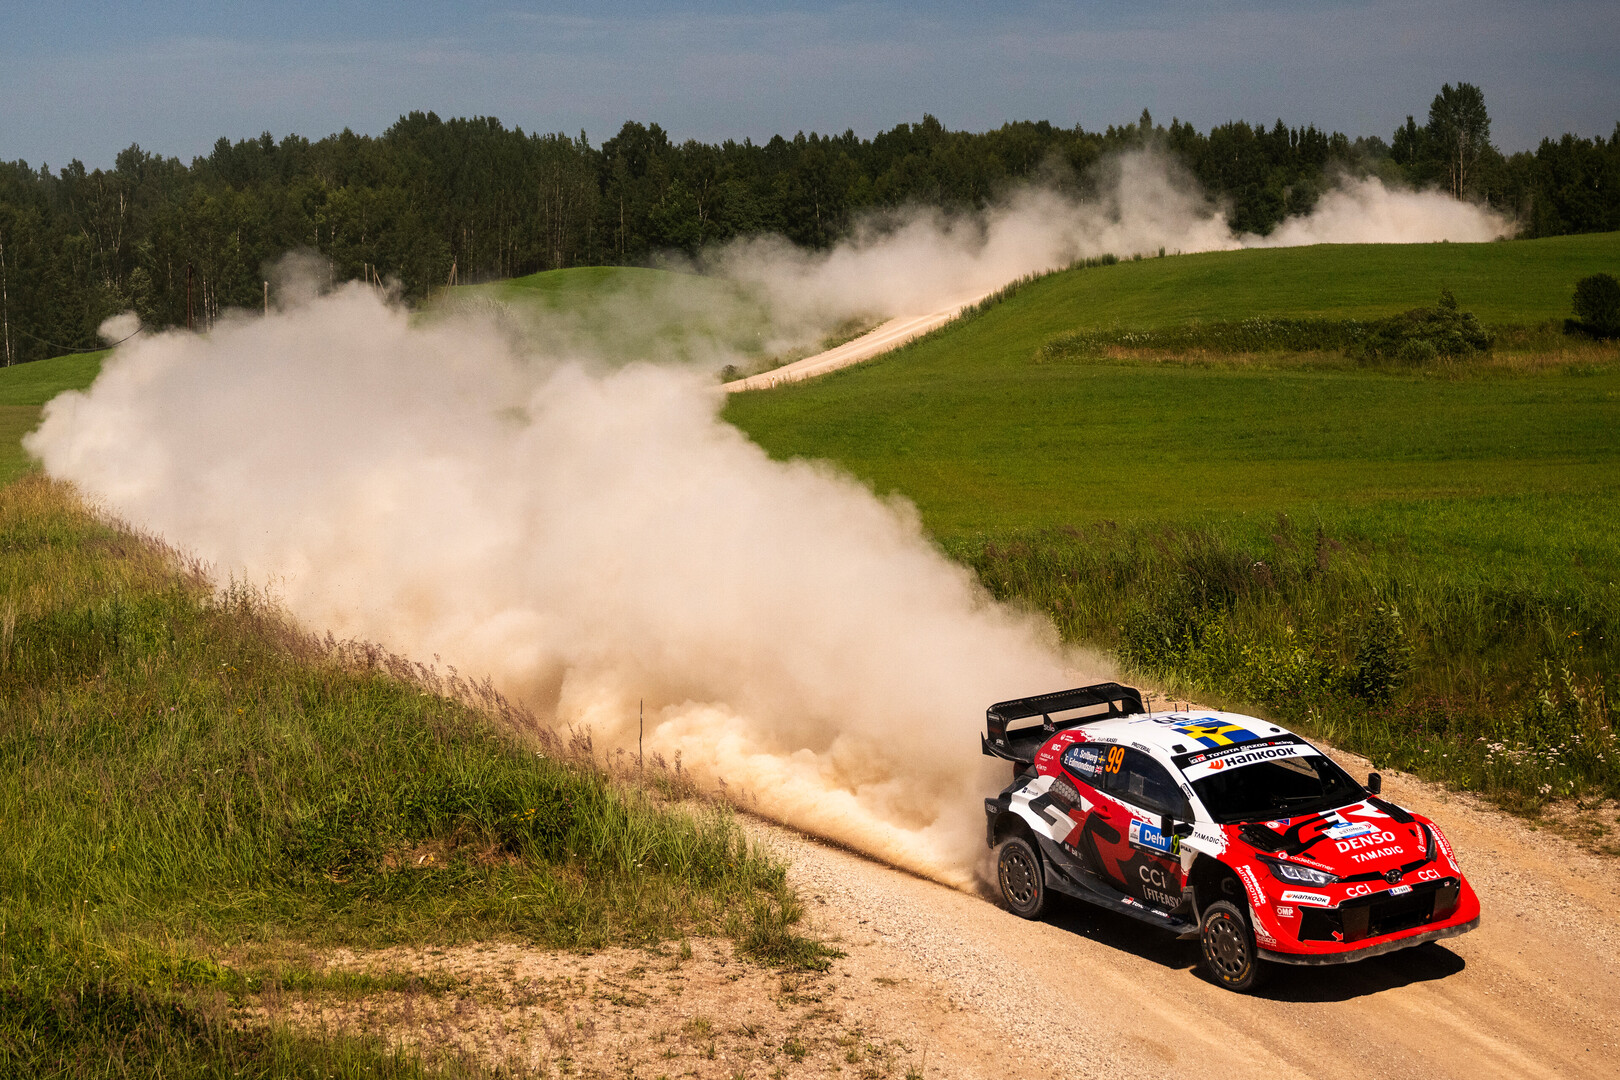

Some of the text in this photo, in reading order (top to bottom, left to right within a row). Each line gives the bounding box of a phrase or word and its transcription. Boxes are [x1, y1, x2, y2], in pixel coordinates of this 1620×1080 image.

[1073, 748, 1098, 765] O. Solberg
[1105, 746, 1125, 774] 99
[1206, 747, 1240, 759] TOYOTA
[1068, 757, 1095, 773] Edmondson
[1194, 832, 1219, 845] TAMADIC
[1335, 831, 1396, 854] DENSO
[1351, 846, 1404, 863] TAMADIC
[1290, 855, 1336, 872] codebeamer
[1235, 866, 1261, 907] AUTOMOTIVE
[1242, 865, 1266, 904] Panasonic
[1277, 907, 1294, 916] OMP
